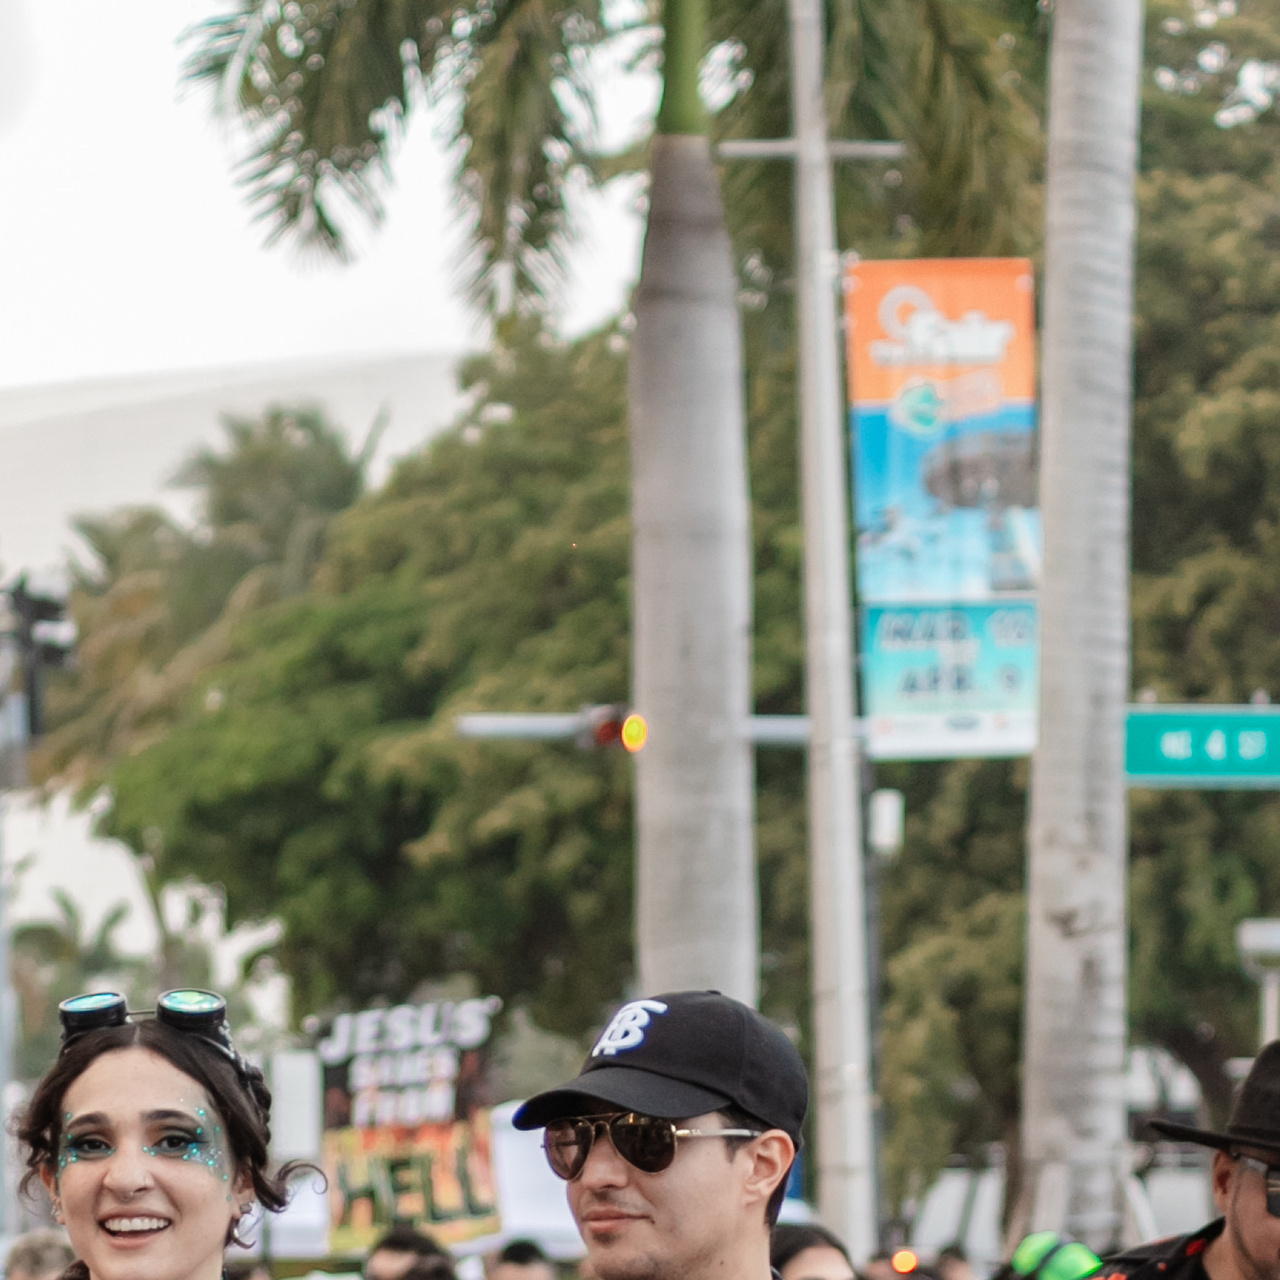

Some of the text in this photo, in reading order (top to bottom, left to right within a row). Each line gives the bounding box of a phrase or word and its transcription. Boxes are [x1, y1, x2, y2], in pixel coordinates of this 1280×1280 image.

[1205, 729, 1227, 761] 4
[318, 998, 492, 1067] JESUS
[336, 1146, 497, 1228] HELL
